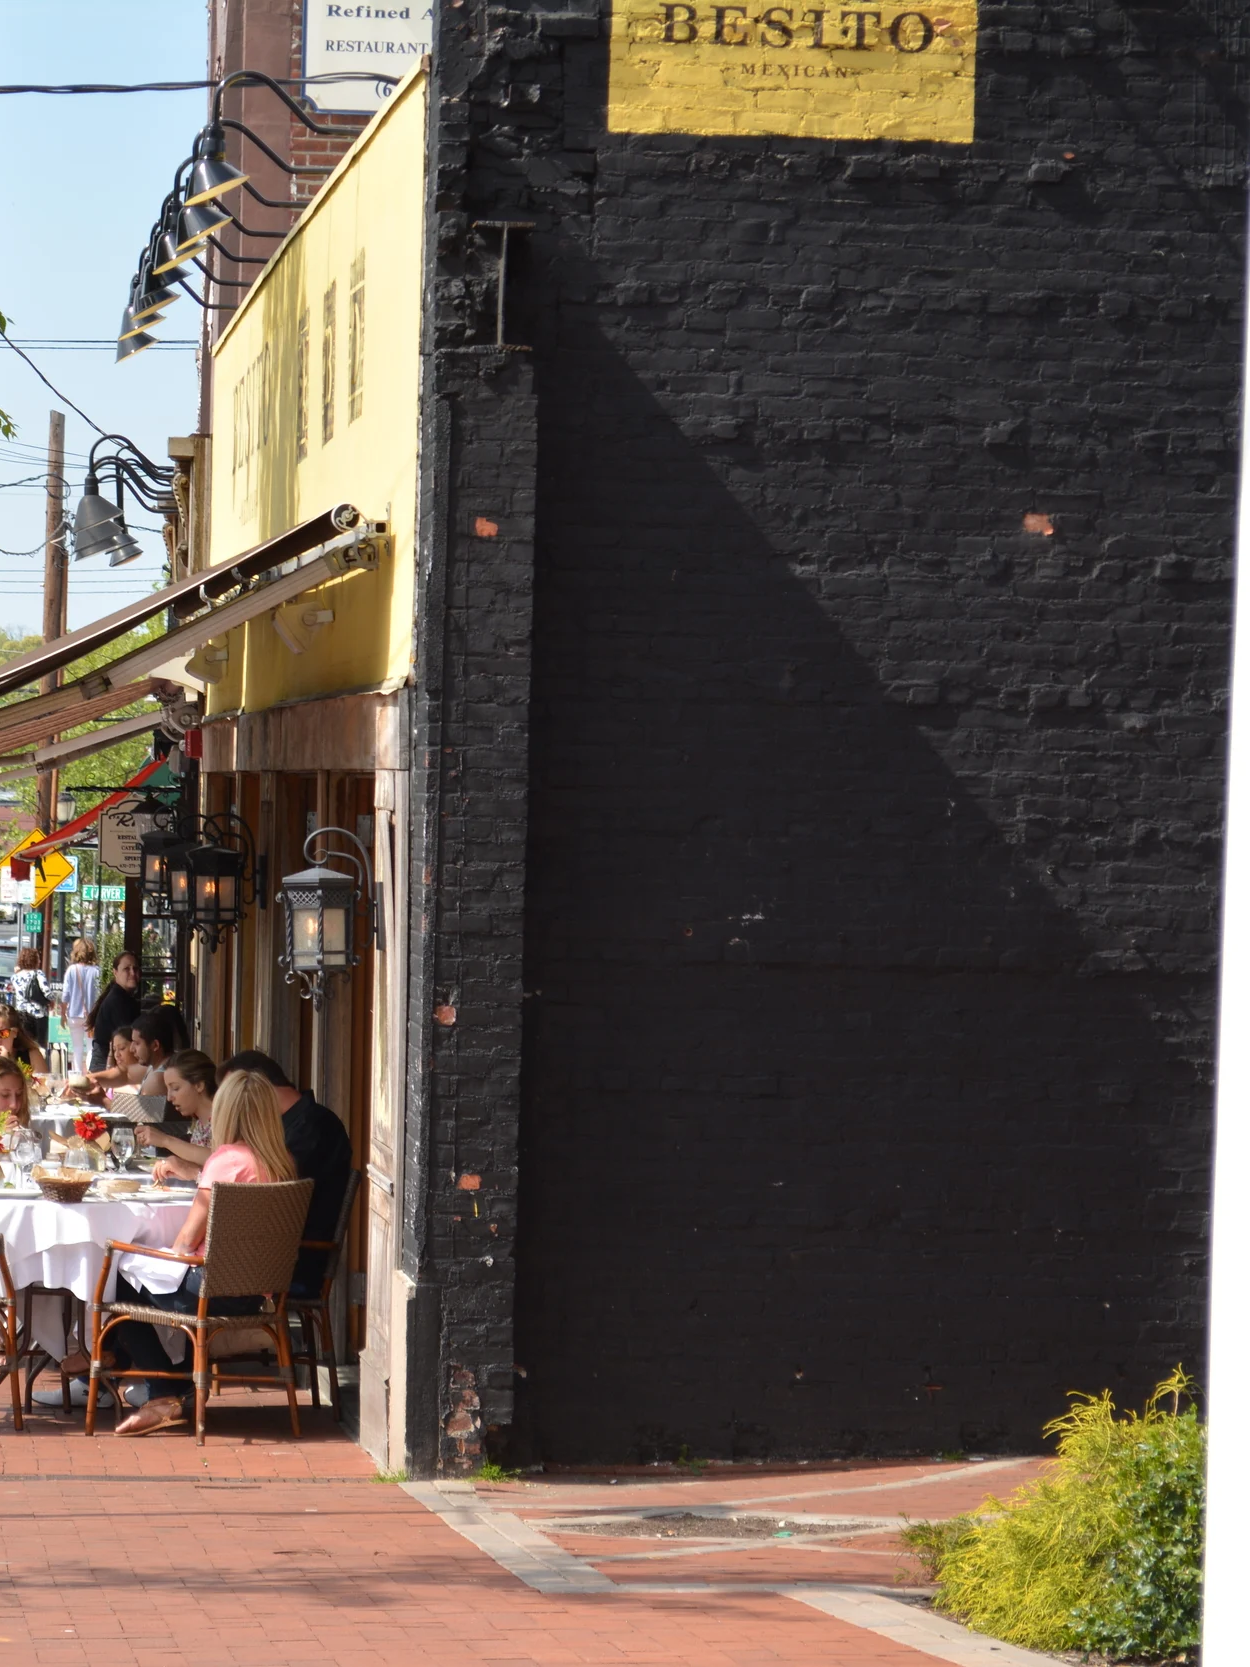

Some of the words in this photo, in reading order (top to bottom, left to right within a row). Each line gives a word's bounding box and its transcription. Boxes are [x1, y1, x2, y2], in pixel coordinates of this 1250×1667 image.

[326, 4, 411, 20] Refined
[659, 2, 937, 53] BESITO
[740, 63, 851, 79] MEXICAN
[83, 887, 89, 898] E
